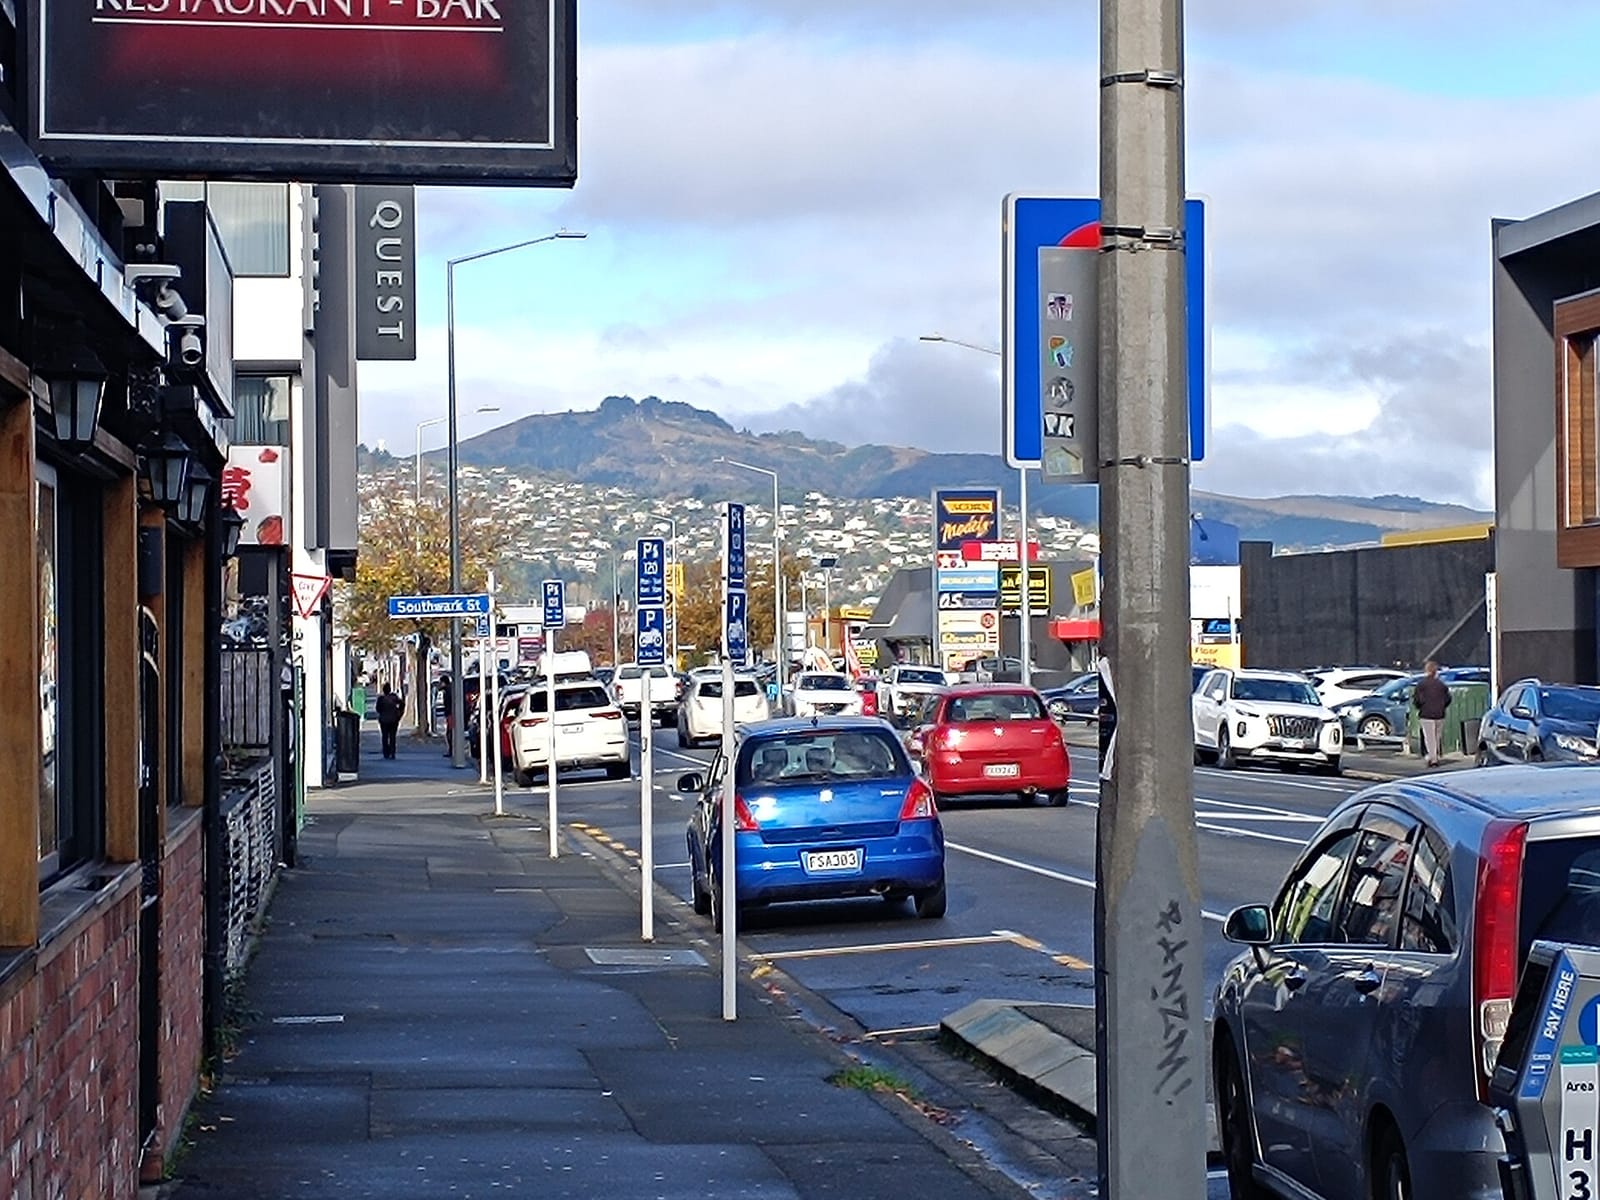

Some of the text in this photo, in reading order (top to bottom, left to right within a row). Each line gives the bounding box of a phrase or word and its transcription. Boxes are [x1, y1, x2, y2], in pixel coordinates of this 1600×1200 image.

[415, 0, 501, 20] BAR
[369, 199, 404, 341] QUEST
[396, 598, 481, 613] Southwark St
[645, 610, 656, 628] P
[809, 852, 857, 869] FSA303
[1543, 970, 1574, 1040] PAY HERE
[1565, 1080, 1595, 1092] Area
